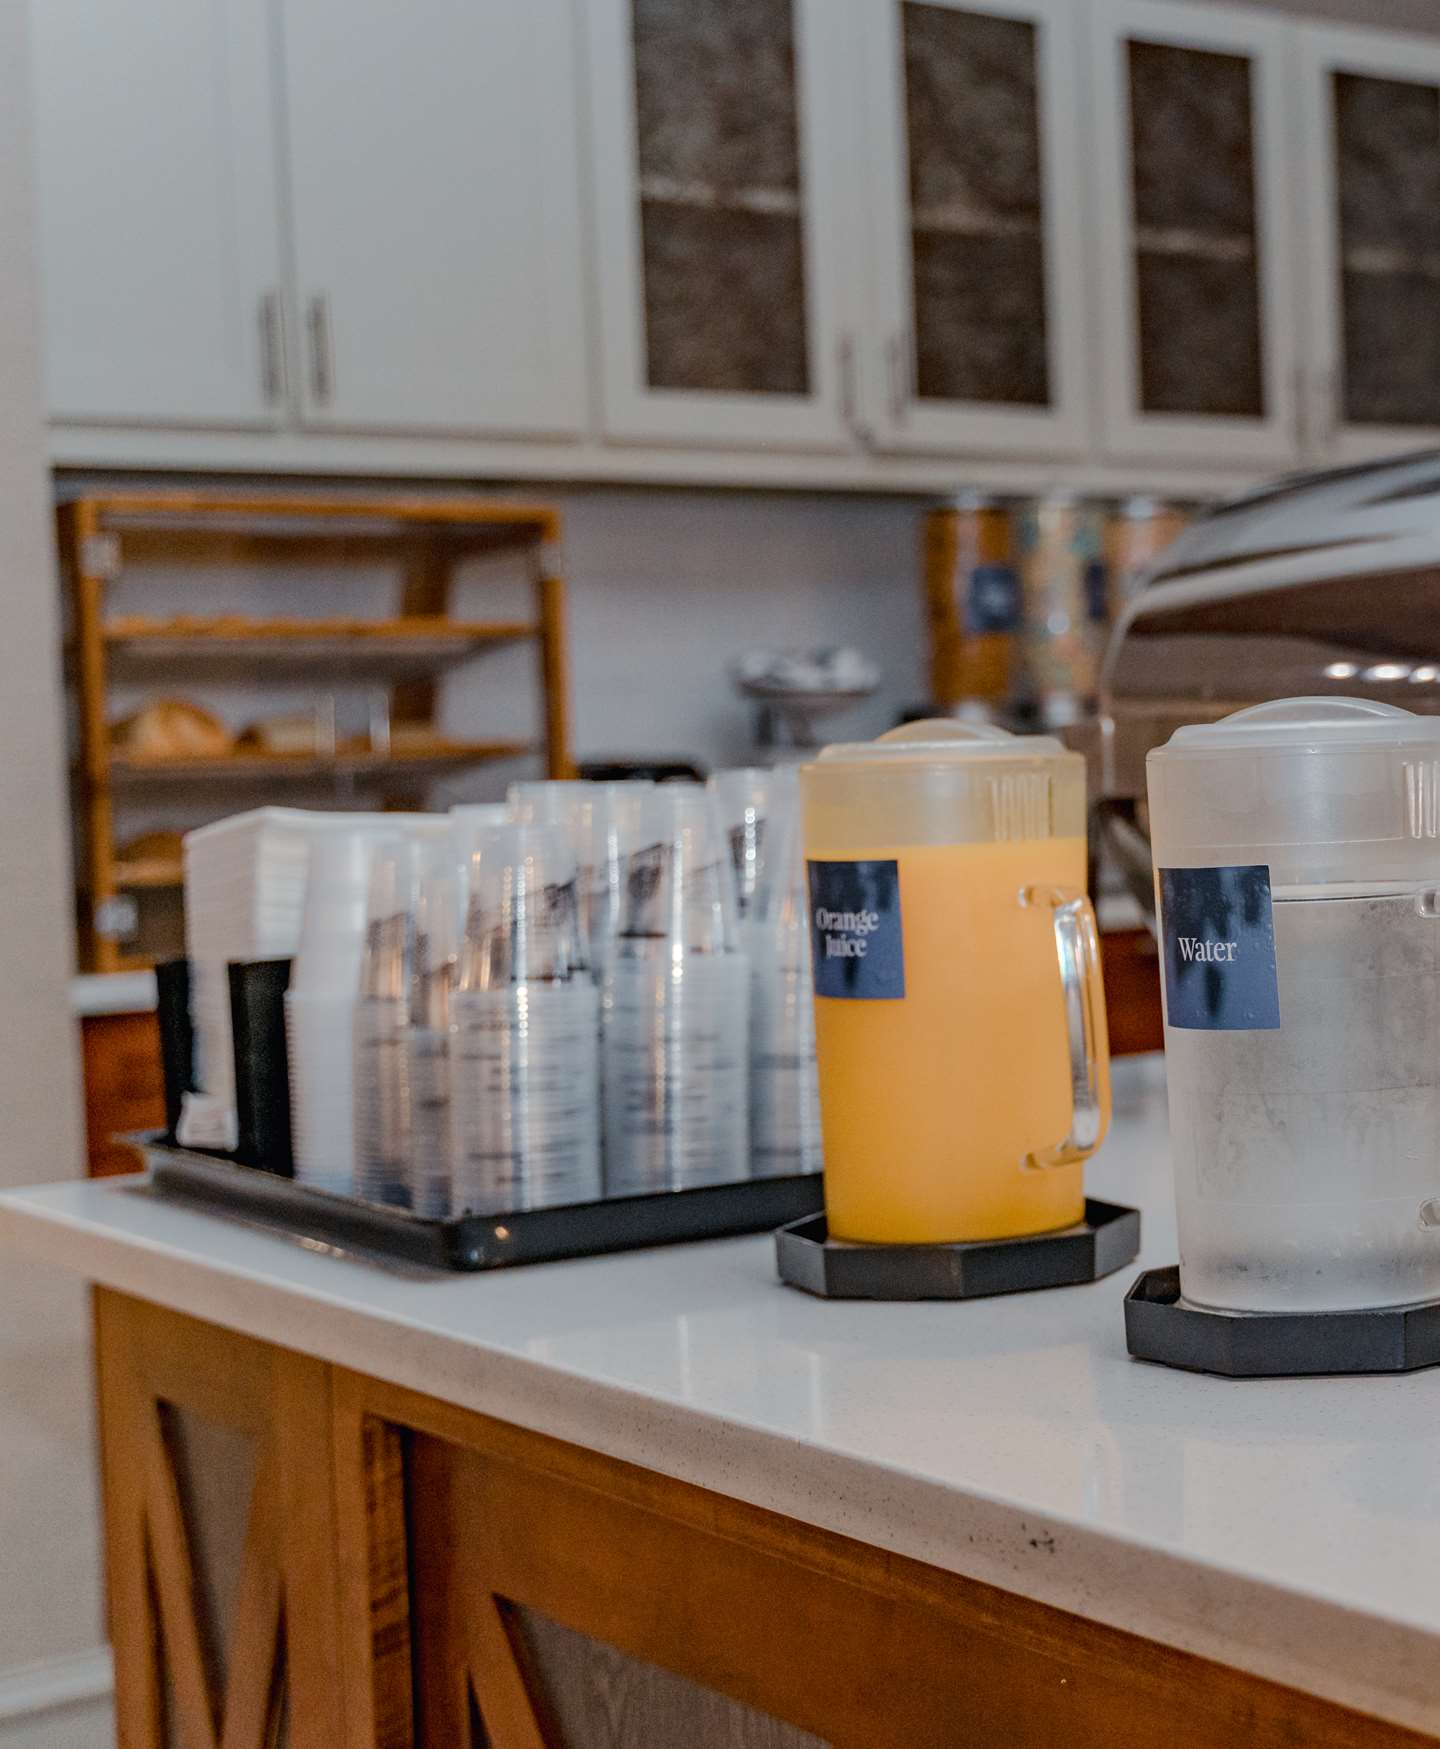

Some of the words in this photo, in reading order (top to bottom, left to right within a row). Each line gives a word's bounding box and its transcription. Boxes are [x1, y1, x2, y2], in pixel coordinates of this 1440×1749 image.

[815, 908, 880, 935] Orange
[826, 933, 868, 959] Juice
[1178, 937, 1238, 962] Water
